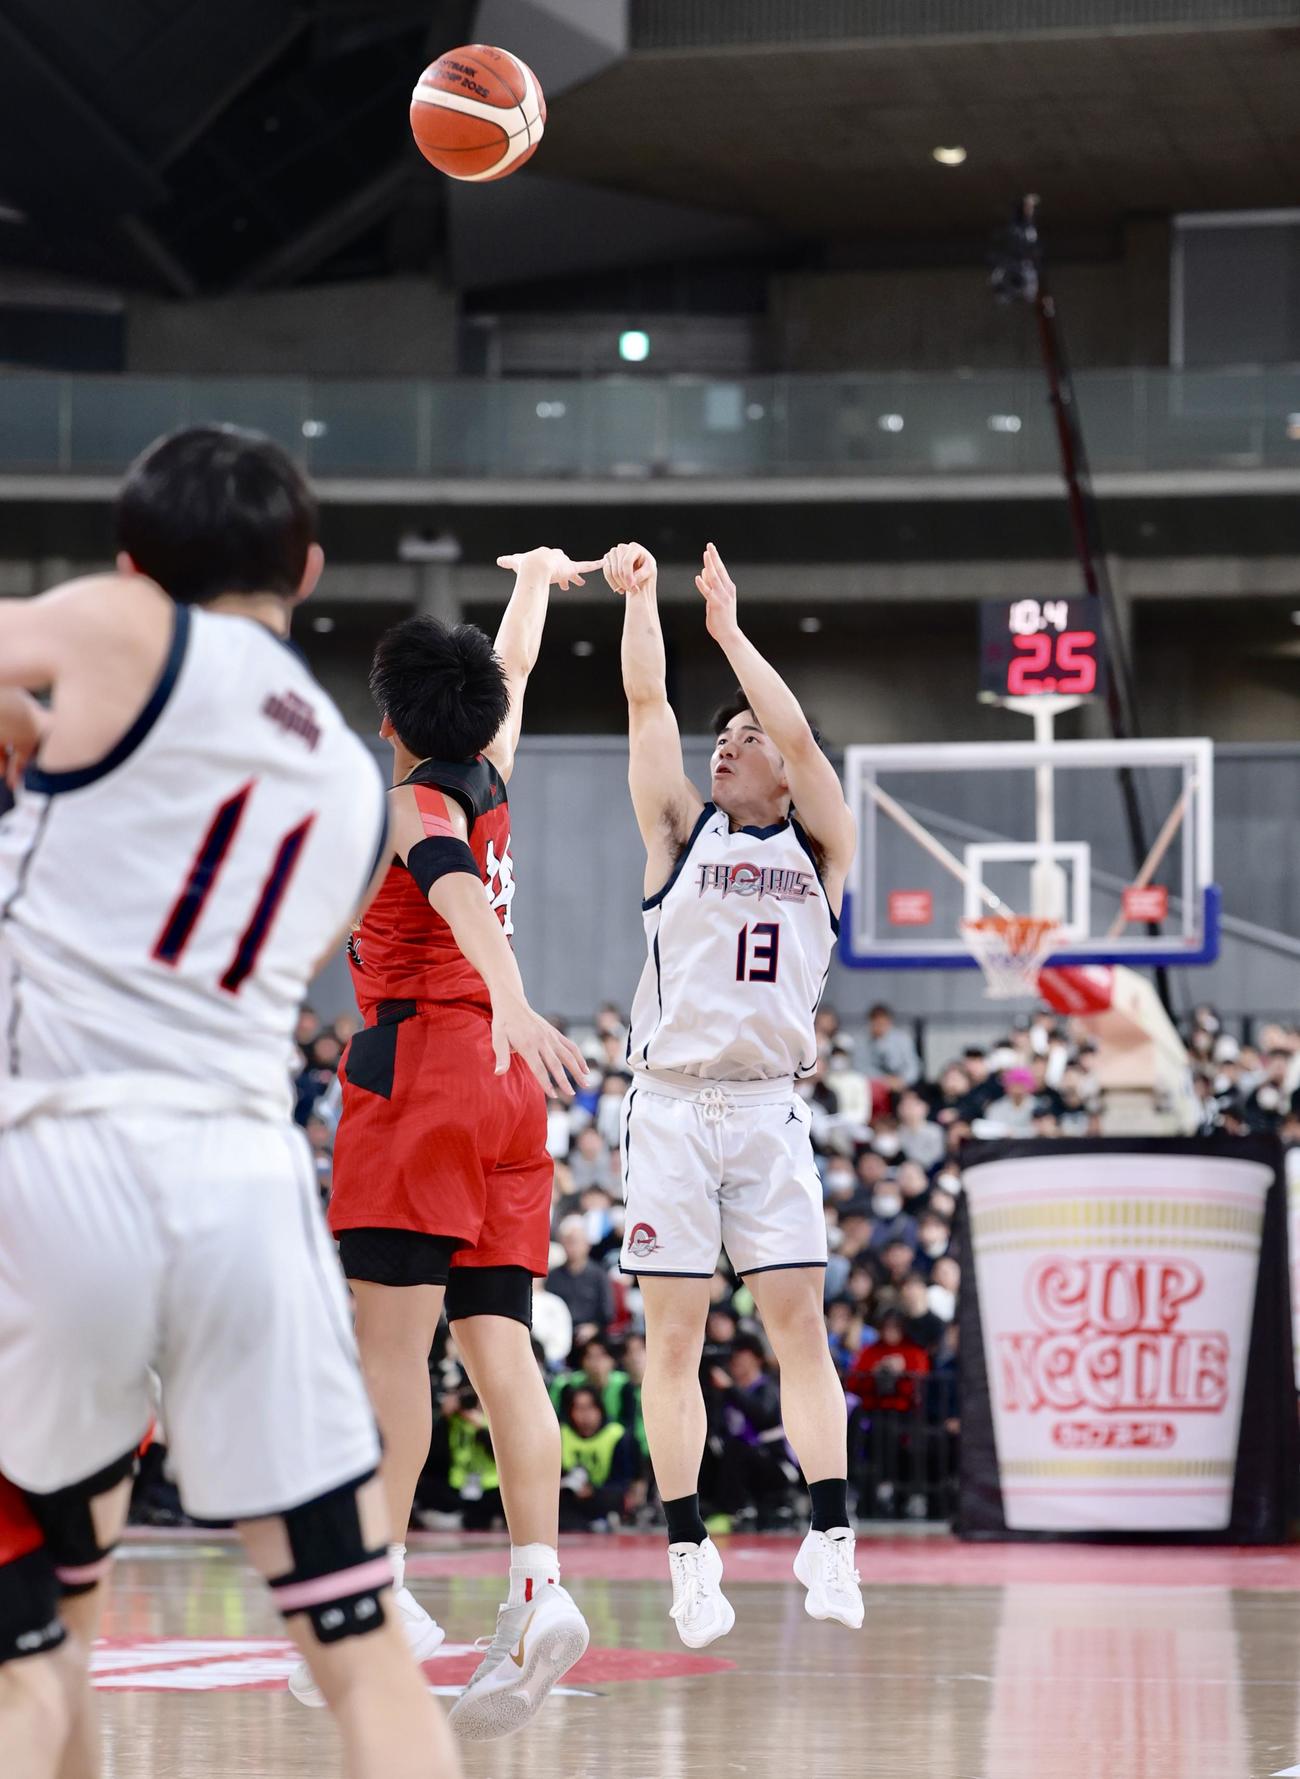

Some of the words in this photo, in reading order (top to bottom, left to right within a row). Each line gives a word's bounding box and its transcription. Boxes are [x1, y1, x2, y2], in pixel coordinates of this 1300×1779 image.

[462, 78, 489, 98] 2025
[152, 776, 318, 993] 11
[736, 922, 780, 983] 13
[1026, 1256, 1203, 1335] CUP
[994, 1330, 1229, 1414] NOODLE
